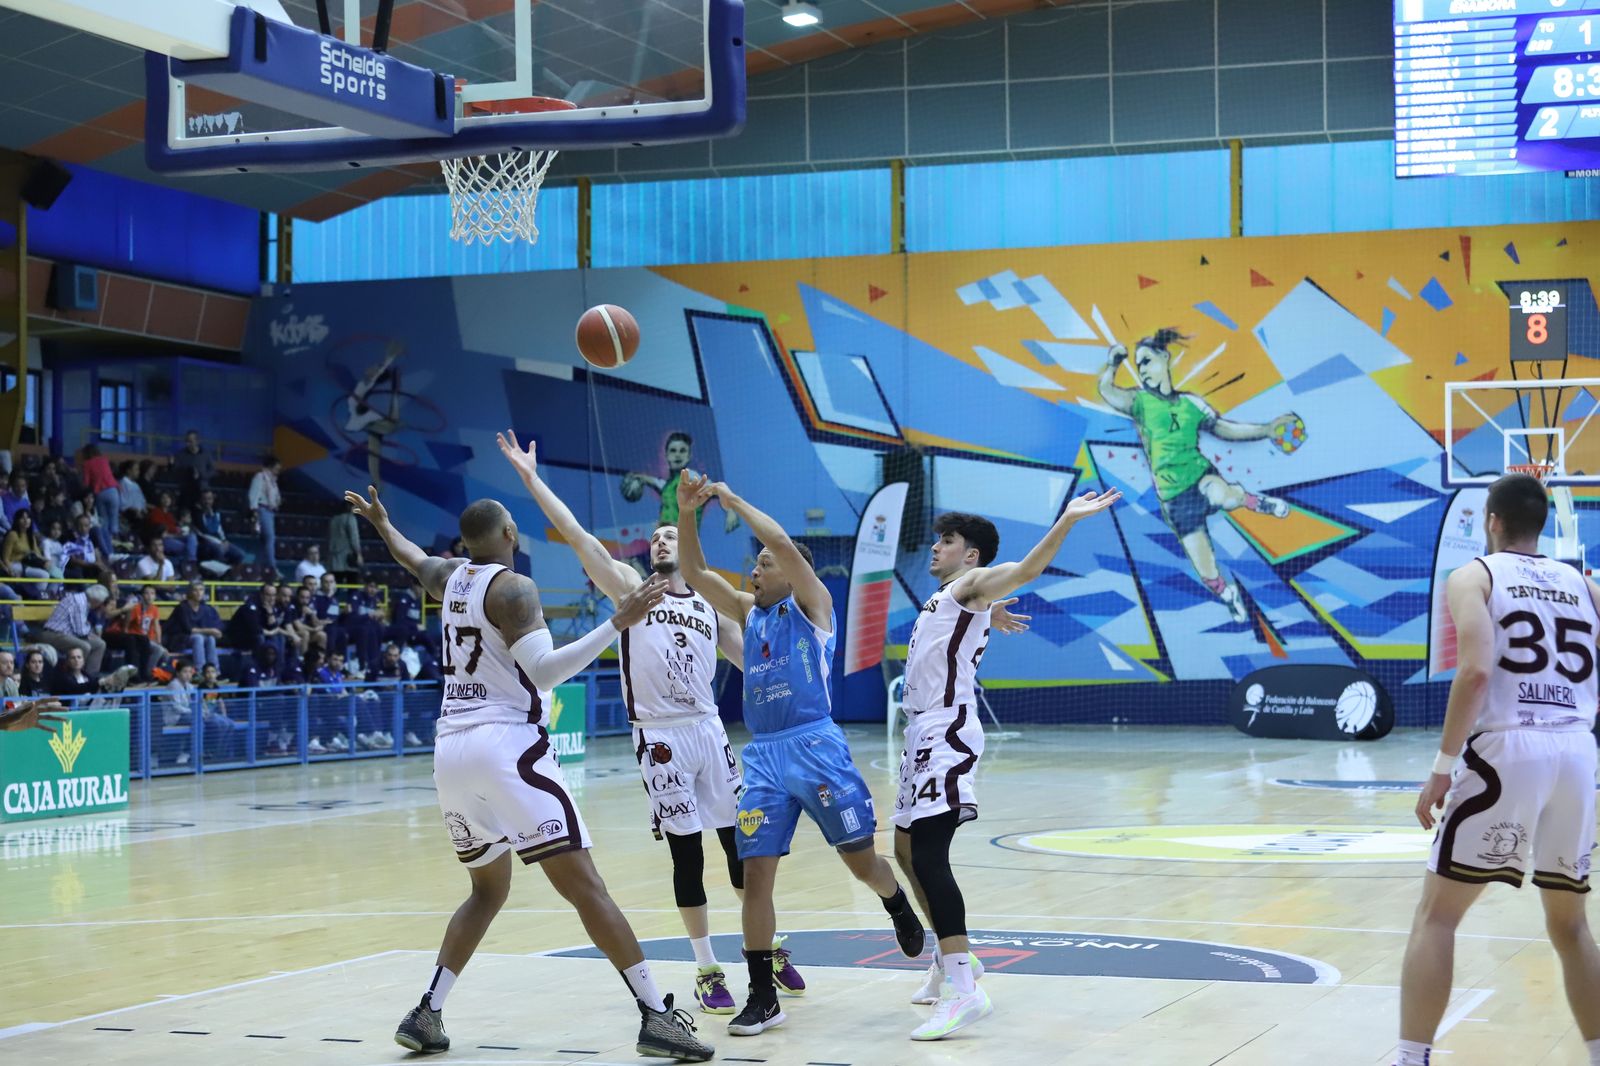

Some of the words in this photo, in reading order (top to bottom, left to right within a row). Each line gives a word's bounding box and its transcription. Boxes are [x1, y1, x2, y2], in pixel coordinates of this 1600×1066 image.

[1579, 19, 1592, 45] 1
[320, 41, 386, 80] Schelde
[320, 63, 386, 101] Sports
[1538, 108, 1559, 137] 2
[1520, 290, 1560, 307] 8:39
[1526, 313, 1548, 344] 8
[1506, 585, 1580, 607] TAVITIAN
[645, 610, 712, 640] TORMES
[674, 632, 687, 648] 3
[443, 623, 484, 676] 17
[1498, 609, 1594, 684] 35
[3, 780, 57, 814] CAJA
[57, 773, 128, 809] RURAL
